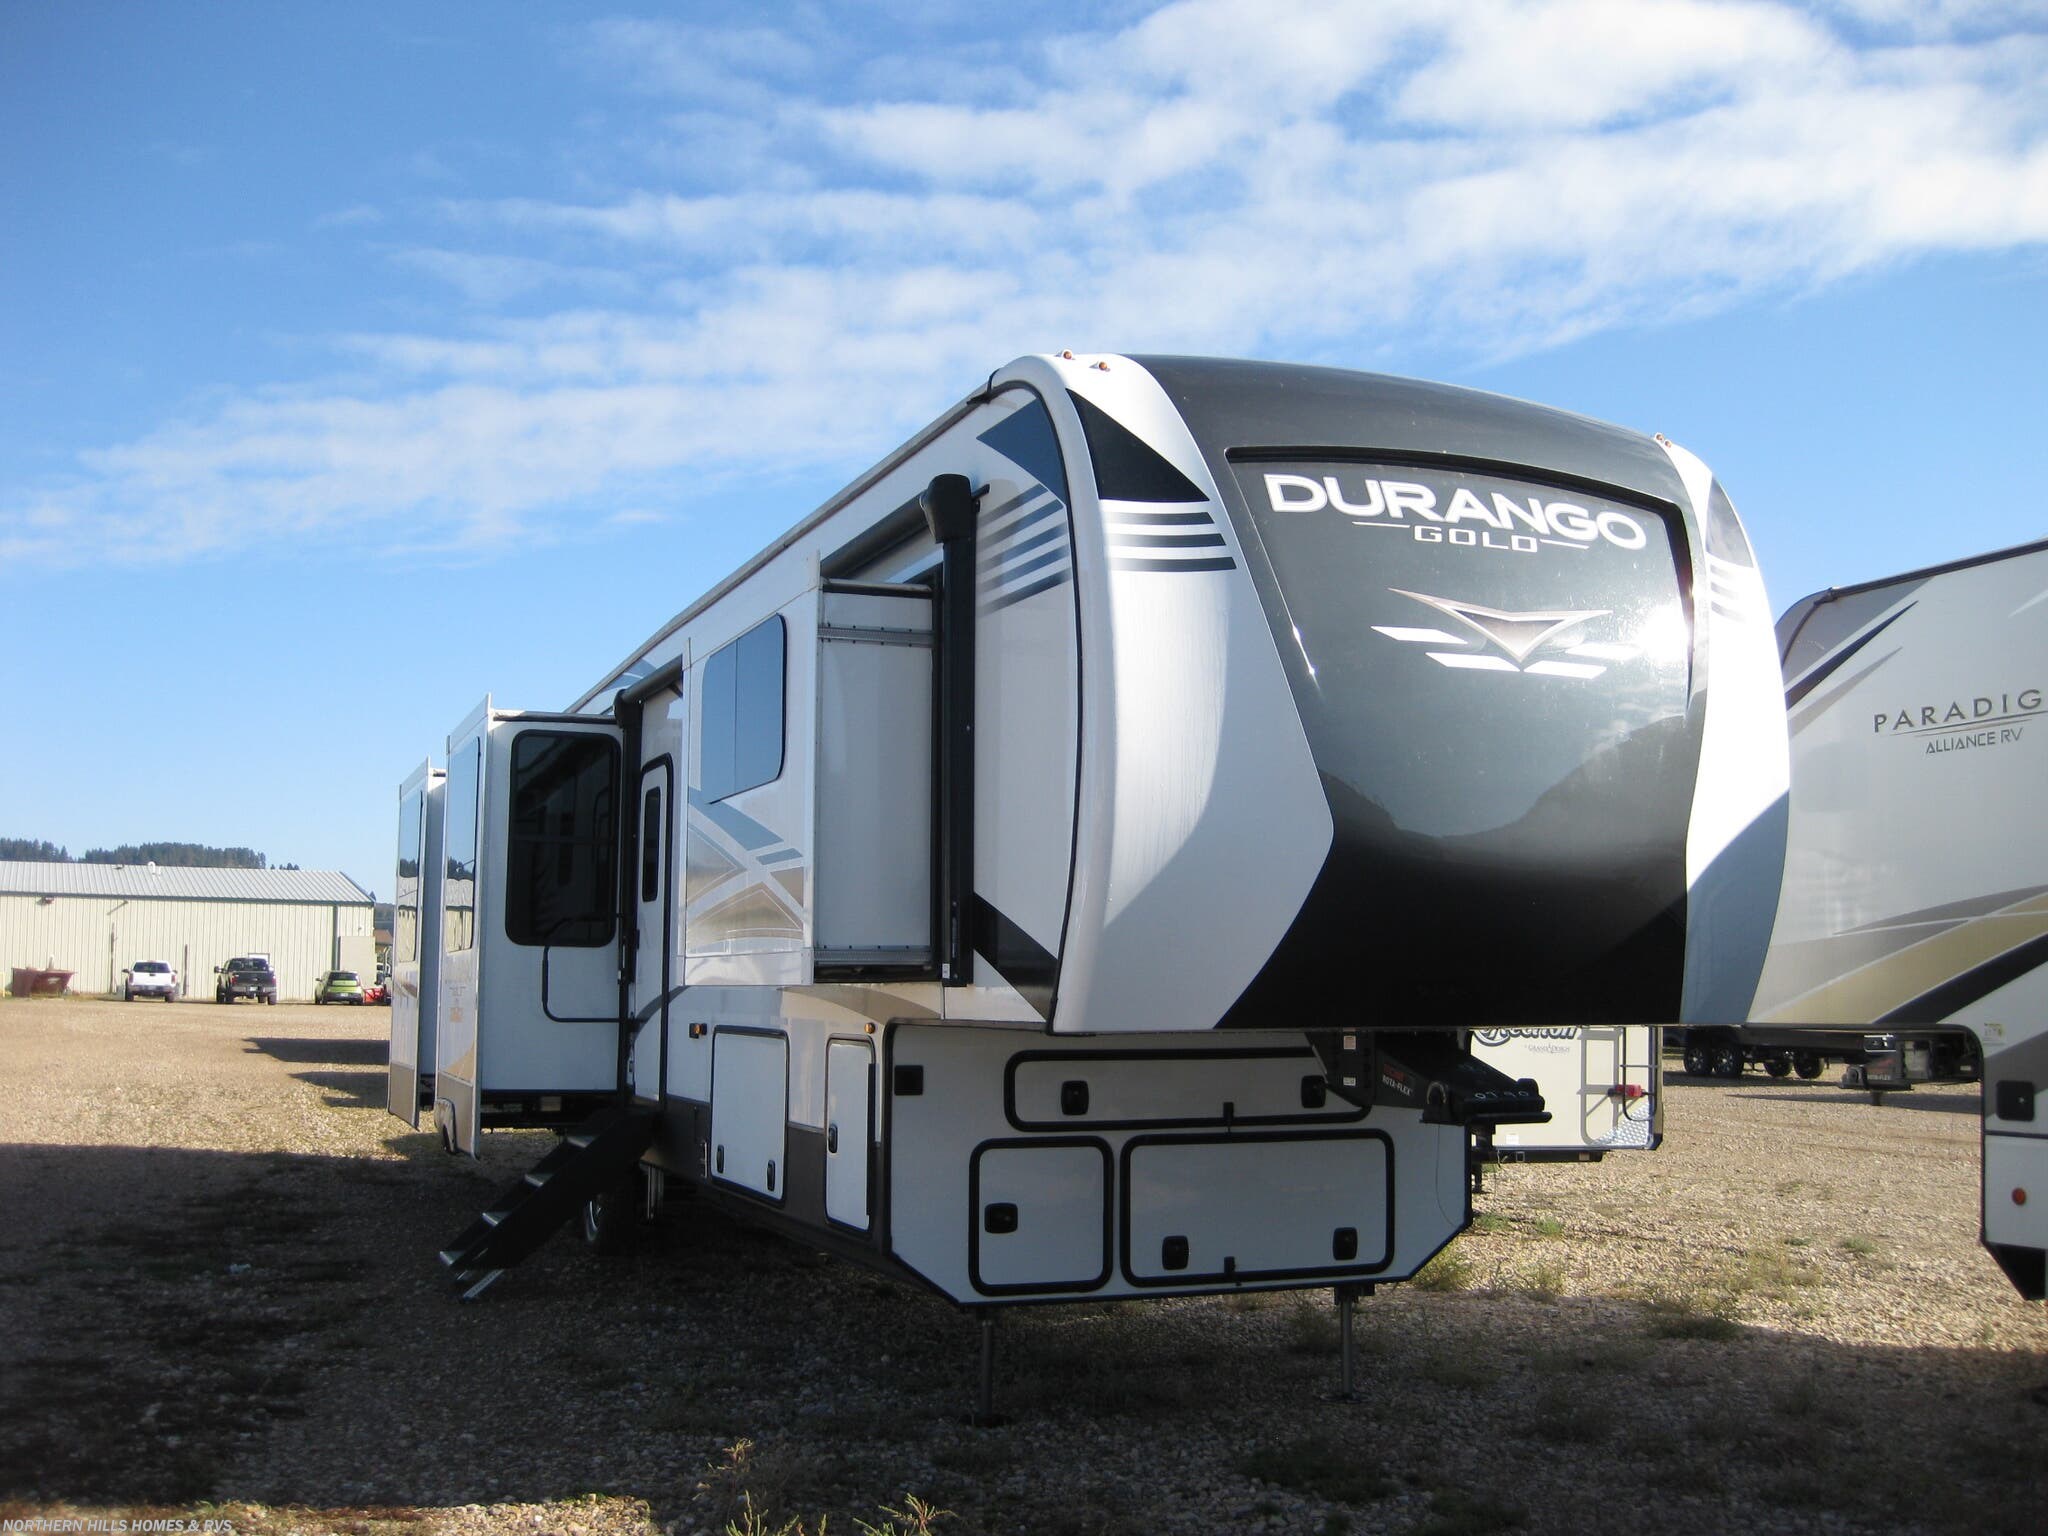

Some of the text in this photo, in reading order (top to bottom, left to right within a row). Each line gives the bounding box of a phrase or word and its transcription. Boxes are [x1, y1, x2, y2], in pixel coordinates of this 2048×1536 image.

[1263, 473, 1647, 550] DURANGO
[1414, 525, 1538, 553] GOLD
[1874, 689, 2042, 733] PARADIG
[1926, 727, 2024, 754] ALLIANCE RV
